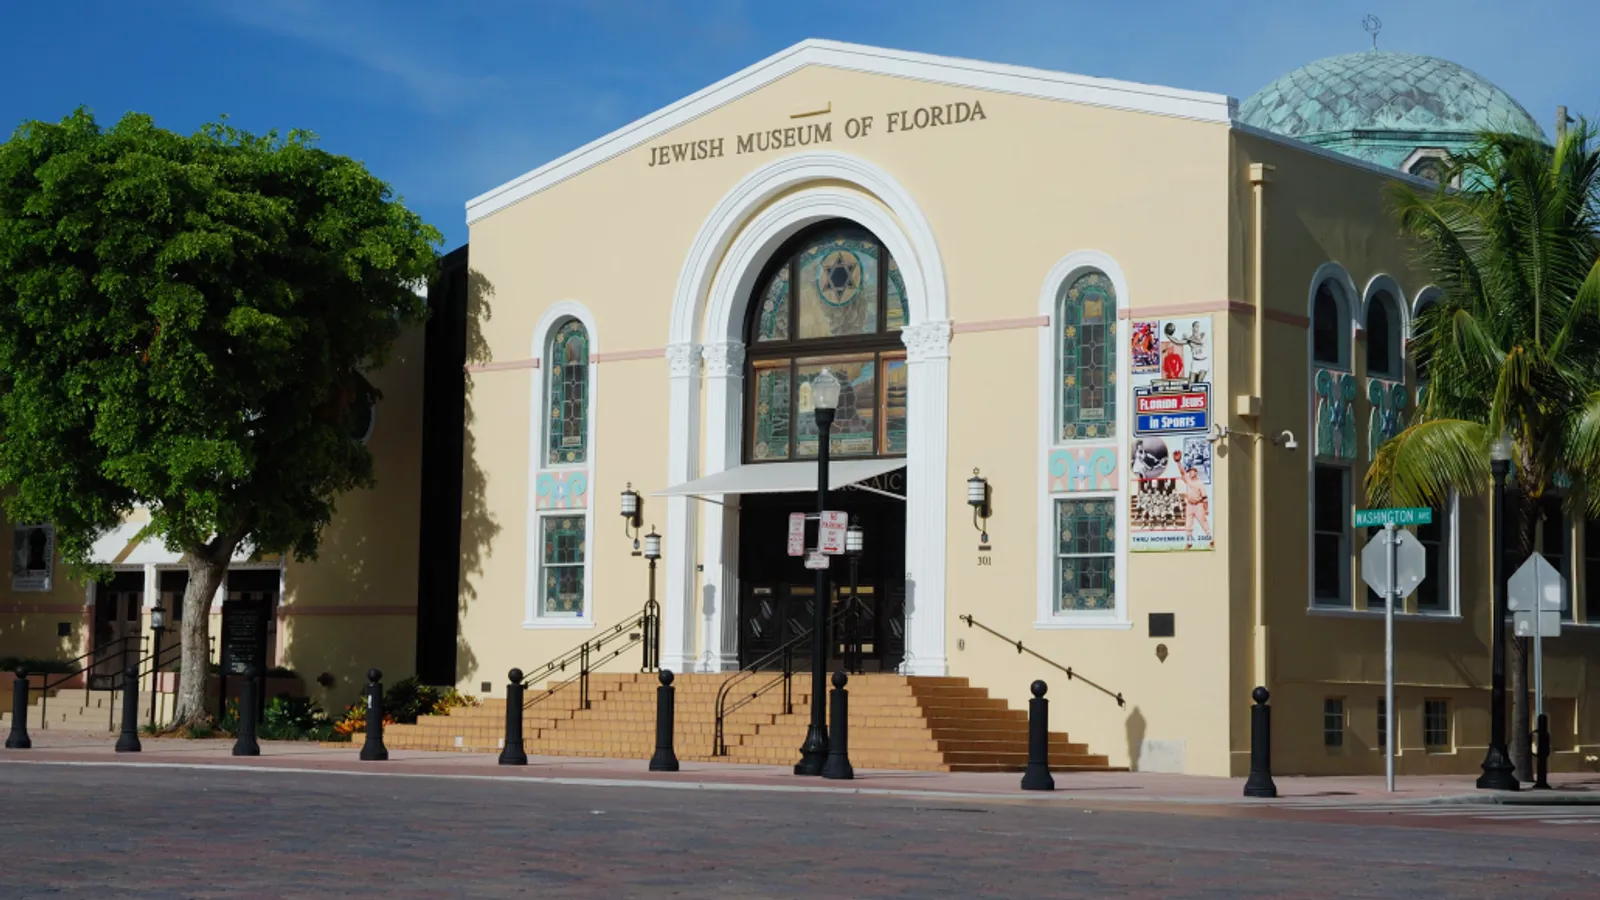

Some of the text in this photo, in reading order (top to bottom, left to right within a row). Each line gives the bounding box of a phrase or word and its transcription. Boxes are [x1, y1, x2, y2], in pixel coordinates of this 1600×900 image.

[648, 100, 987, 167] JEWISH MUSEUM OF FLORIDA
[1139, 398, 1178, 411] FLORIDA
[1356, 510, 1430, 524] WASHINGTON AVE
[1150, 535, 1185, 543] NOVEMBER
